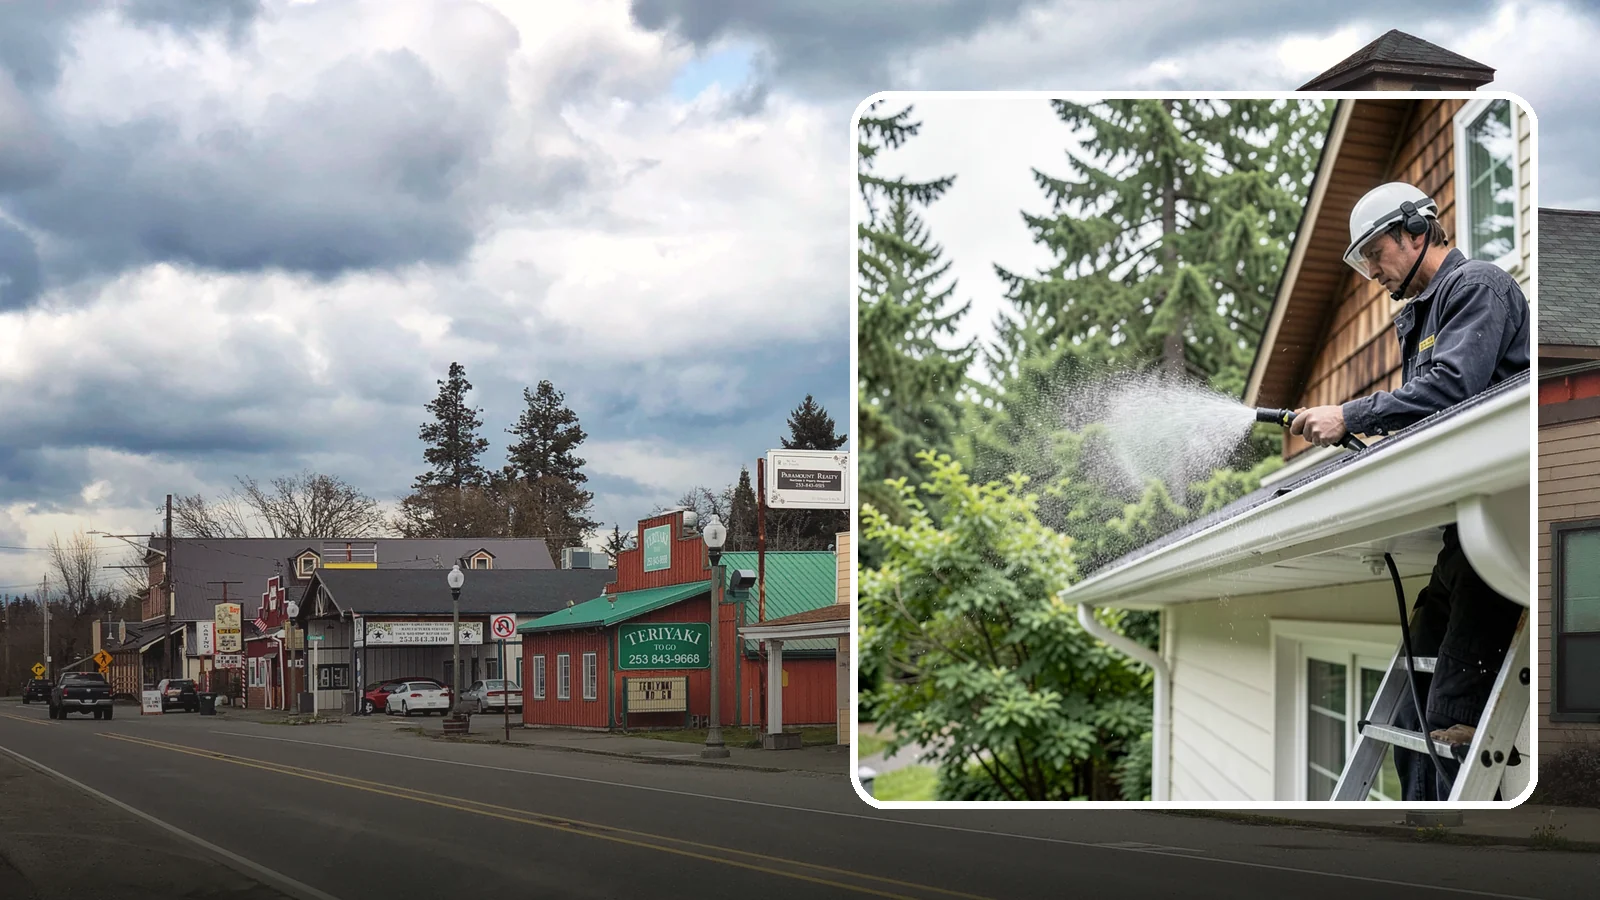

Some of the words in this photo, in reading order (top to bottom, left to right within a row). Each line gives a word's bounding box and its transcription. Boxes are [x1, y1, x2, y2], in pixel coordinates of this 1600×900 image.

[625, 627, 702, 646] TERIYAKI
[628, 654, 649, 664] 253
[651, 653, 700, 664] 843-9668
[639, 681, 673, 691] TERIYAKI
